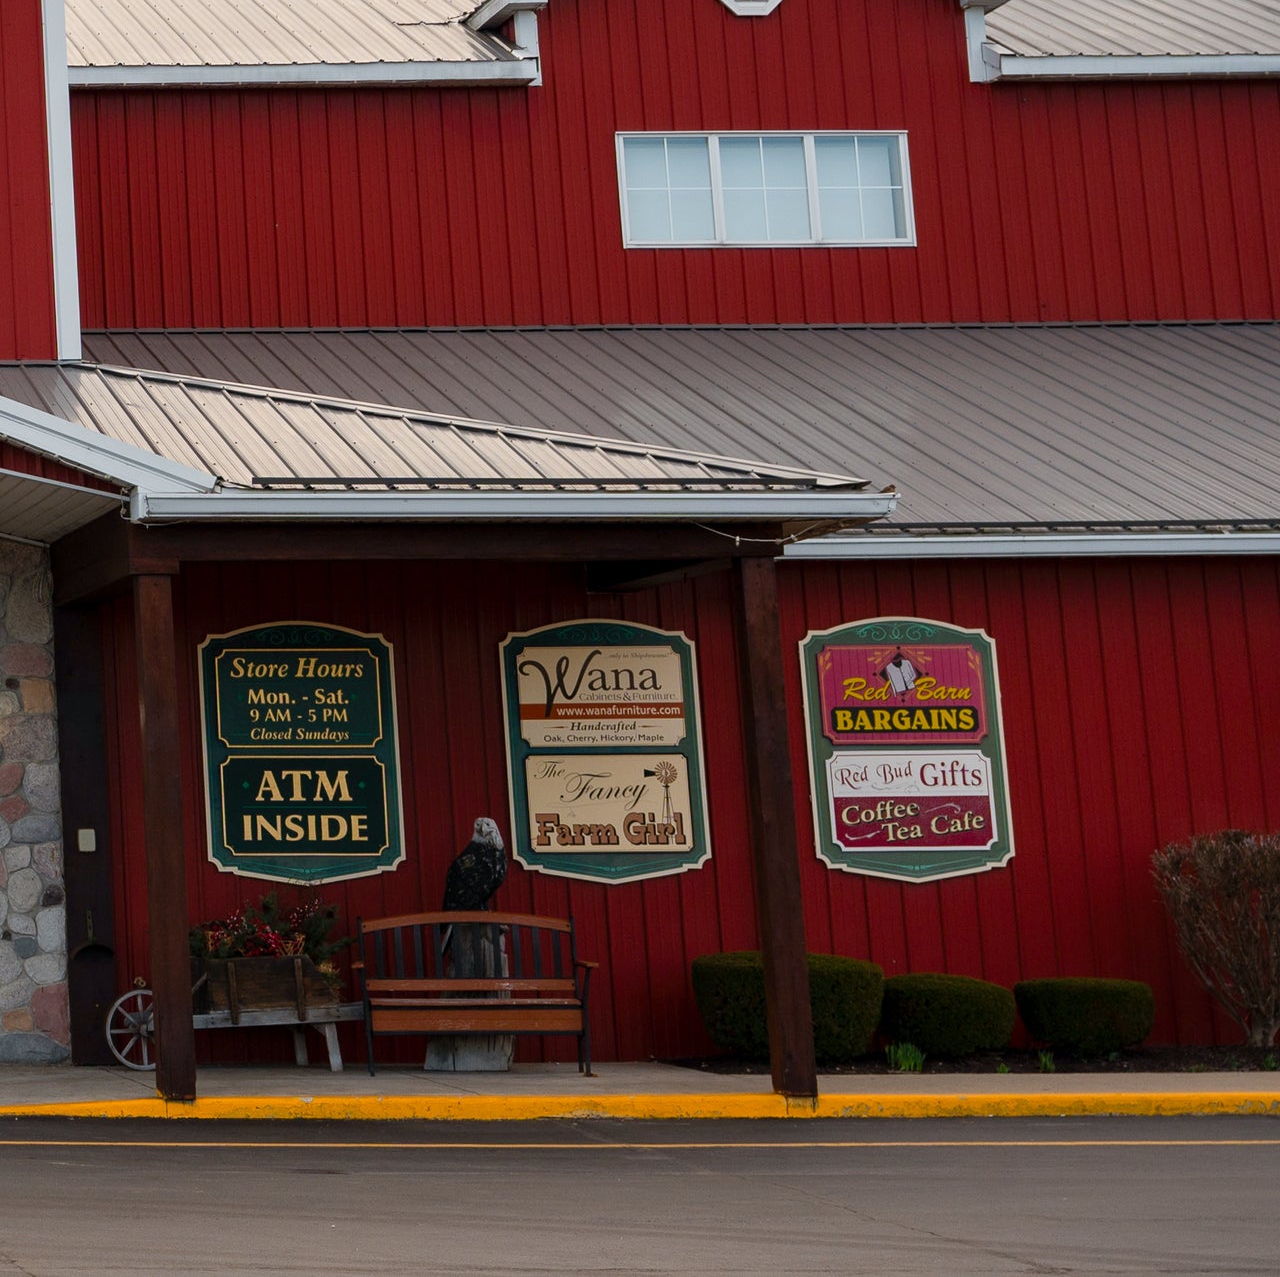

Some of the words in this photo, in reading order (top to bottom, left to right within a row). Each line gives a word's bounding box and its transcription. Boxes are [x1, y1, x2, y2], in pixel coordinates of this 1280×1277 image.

[230, 657, 288, 678] Store
[295, 657, 363, 678] Hours
[519, 650, 661, 718] Wana
[843, 678, 891, 701] Red
[914, 677, 972, 700] Barn
[248, 689, 296, 704] Mon.
[315, 689, 349, 704] Sat.
[579, 692, 621, 701] Cabinets
[623, 692, 631, 701] &
[250, 709, 259, 722] 9
[265, 709, 291, 722] AM
[308, 709, 316, 722] 5
[323, 709, 348, 722] PM
[557, 705, 680, 716] www.wanafurniture.com
[835, 709, 974, 731] BARGAINS
[250, 728, 291, 740] Closed
[296, 728, 349, 742] Sundays
[544, 734, 565, 743] Oak,
[567, 734, 598, 743] Cherry,
[601, 733, 637, 743] Hickory,
[638, 733, 664, 743] Maple
[570, 721, 636, 733] Handcrafted
[534, 761, 565, 779] The
[834, 765, 868, 790] Red
[876, 761, 912, 785] Bud
[920, 761, 982, 786] Gifts
[255, 770, 353, 801] ATM
[560, 772, 649, 810] Fancy
[842, 801, 919, 825] Coffee
[243, 815, 368, 841] INSIDE
[535, 813, 619, 846] Farm
[623, 812, 686, 845] Girl
[881, 823, 923, 841] Tea
[931, 812, 984, 834] Cafe
